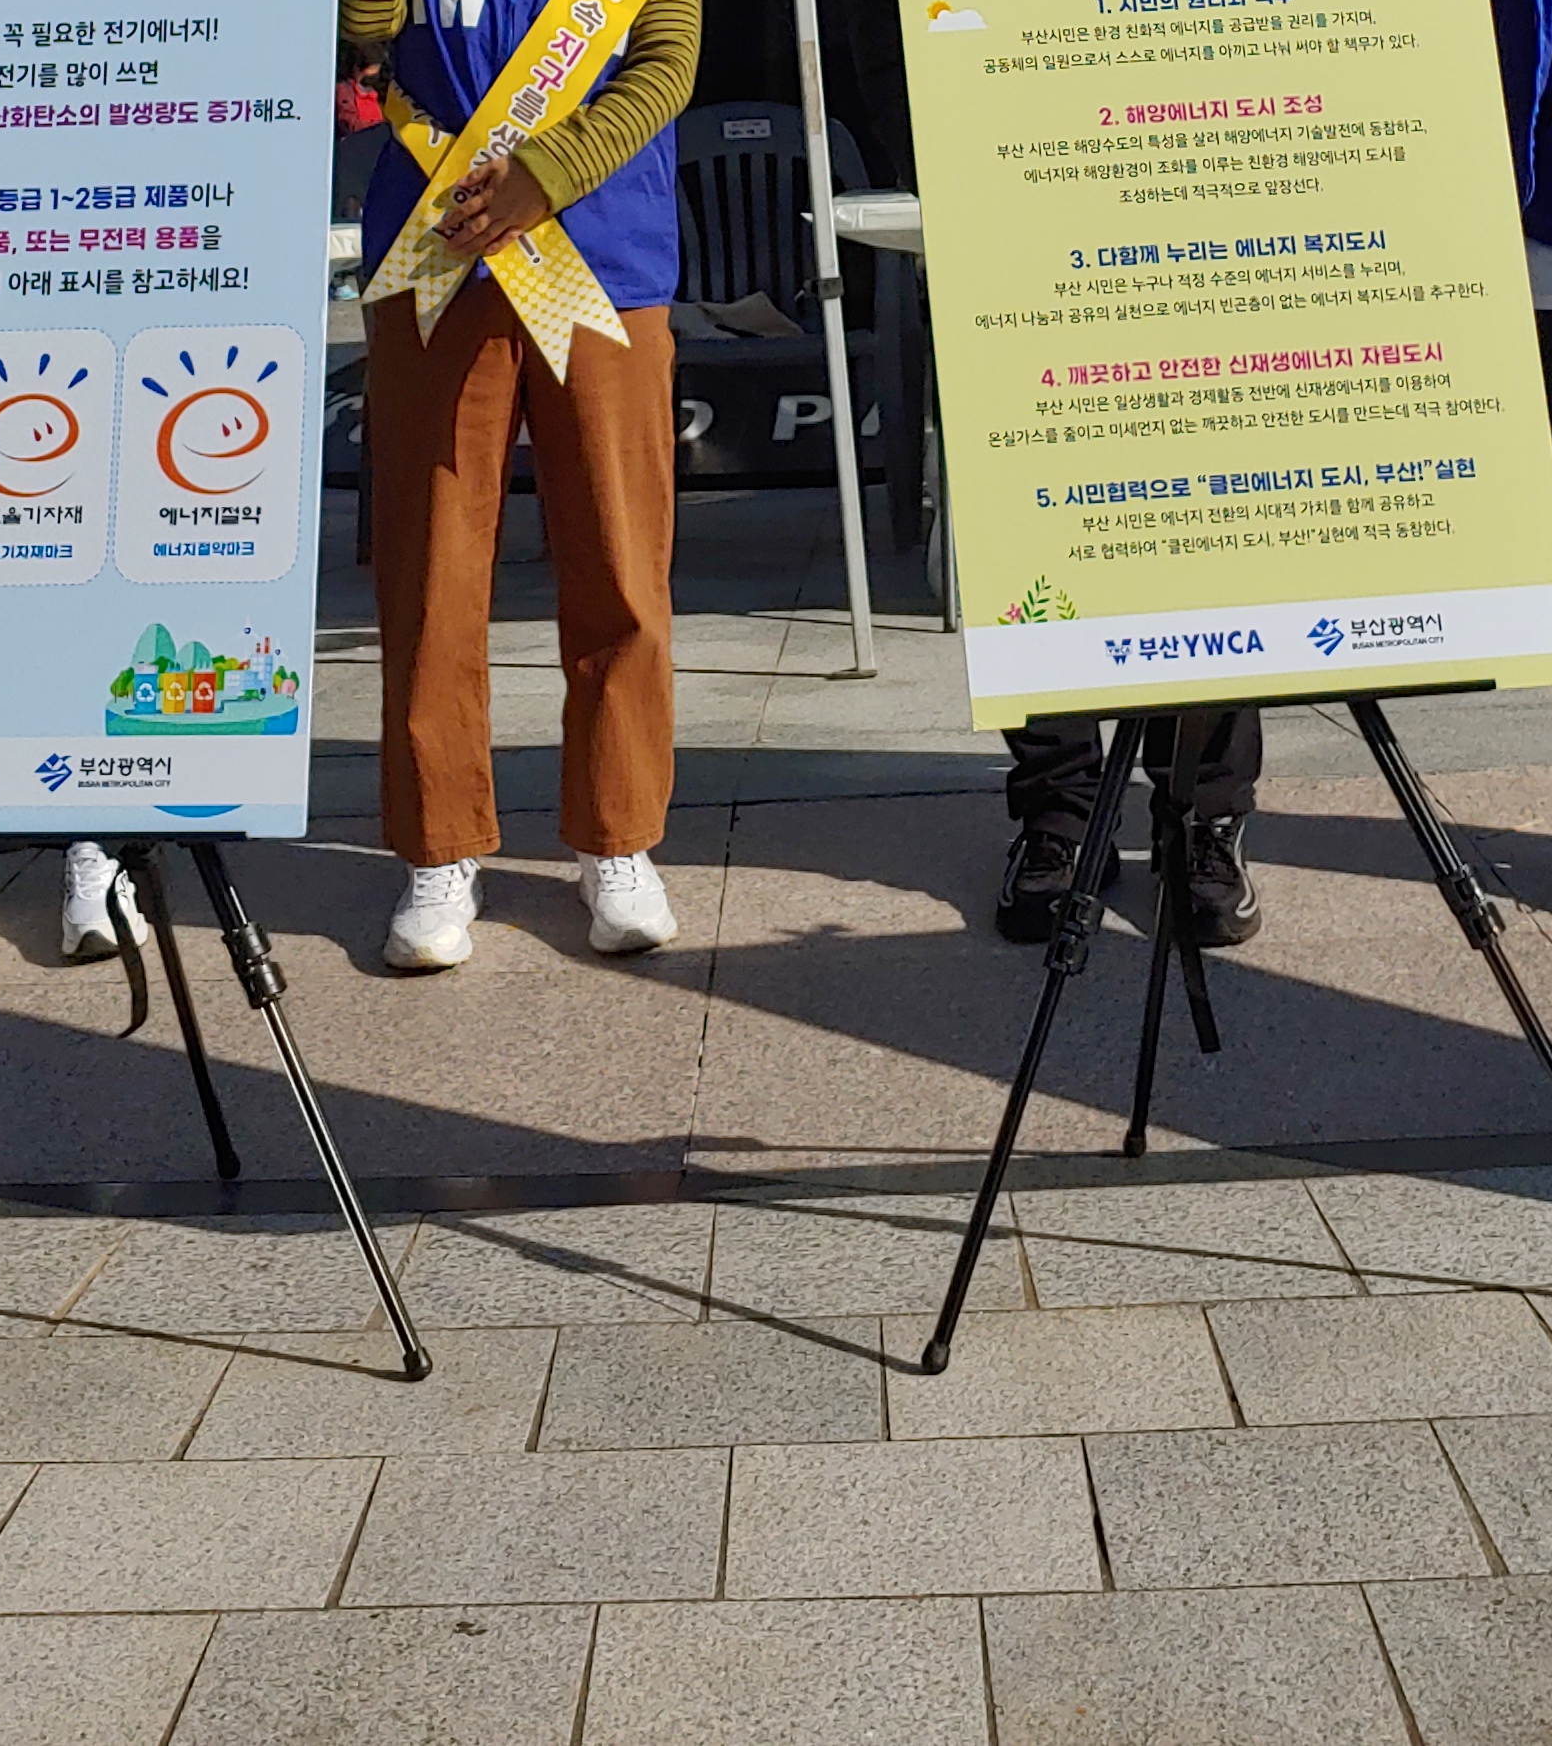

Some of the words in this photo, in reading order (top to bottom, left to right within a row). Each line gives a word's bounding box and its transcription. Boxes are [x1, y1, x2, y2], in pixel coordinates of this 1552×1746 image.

[4, 24, 24, 47] 꼭
[32, 21, 95, 47] 필요한
[104, 18, 218, 44] 전기에너지!
[1022, 28, 1089, 45] 부산시민은
[1094, 26, 1120, 41] 환경
[1126, 23, 1165, 39] 친화적
[1170, 19, 1224, 35] 에너지를
[1229, 16, 1282, 32] 공급받을
[1288, 13, 1327, 29] 권리를
[1332, 11, 1376, 26] 가지며,
[67, 62, 107, 87] 많이
[116, 61, 158, 84] 쓰면
[110, 102, 198, 125] 발생량도
[208, 98, 300, 123] 증가해요.
[1099, 108, 1119, 126] 2.
[1126, 100, 1228, 123] 해양에너지
[1237, 97, 1275, 117] 도시
[1283, 94, 1322, 114] 조성
[51, 186, 136, 209] 1~2등급
[144, 182, 234, 207] 제품이나
[26, 230, 70, 251] 또는
[79, 228, 145, 251] 무전력
[156, 225, 222, 250] 용품을
[1070, 250, 1090, 269] 3.
[1098, 245, 1159, 266] 다함께
[1167, 241, 1227, 262] 누리는
[1236, 236, 1296, 257] 에너지
[1305, 230, 1385, 253] 복지도시
[9, 271, 51, 295] 아래
[59, 270, 124, 294] 표시를
[132, 267, 248, 293] 참고하세요!
[160, 507, 261, 525] 에너지절약
[80, 757, 171, 776] 부산광역시
